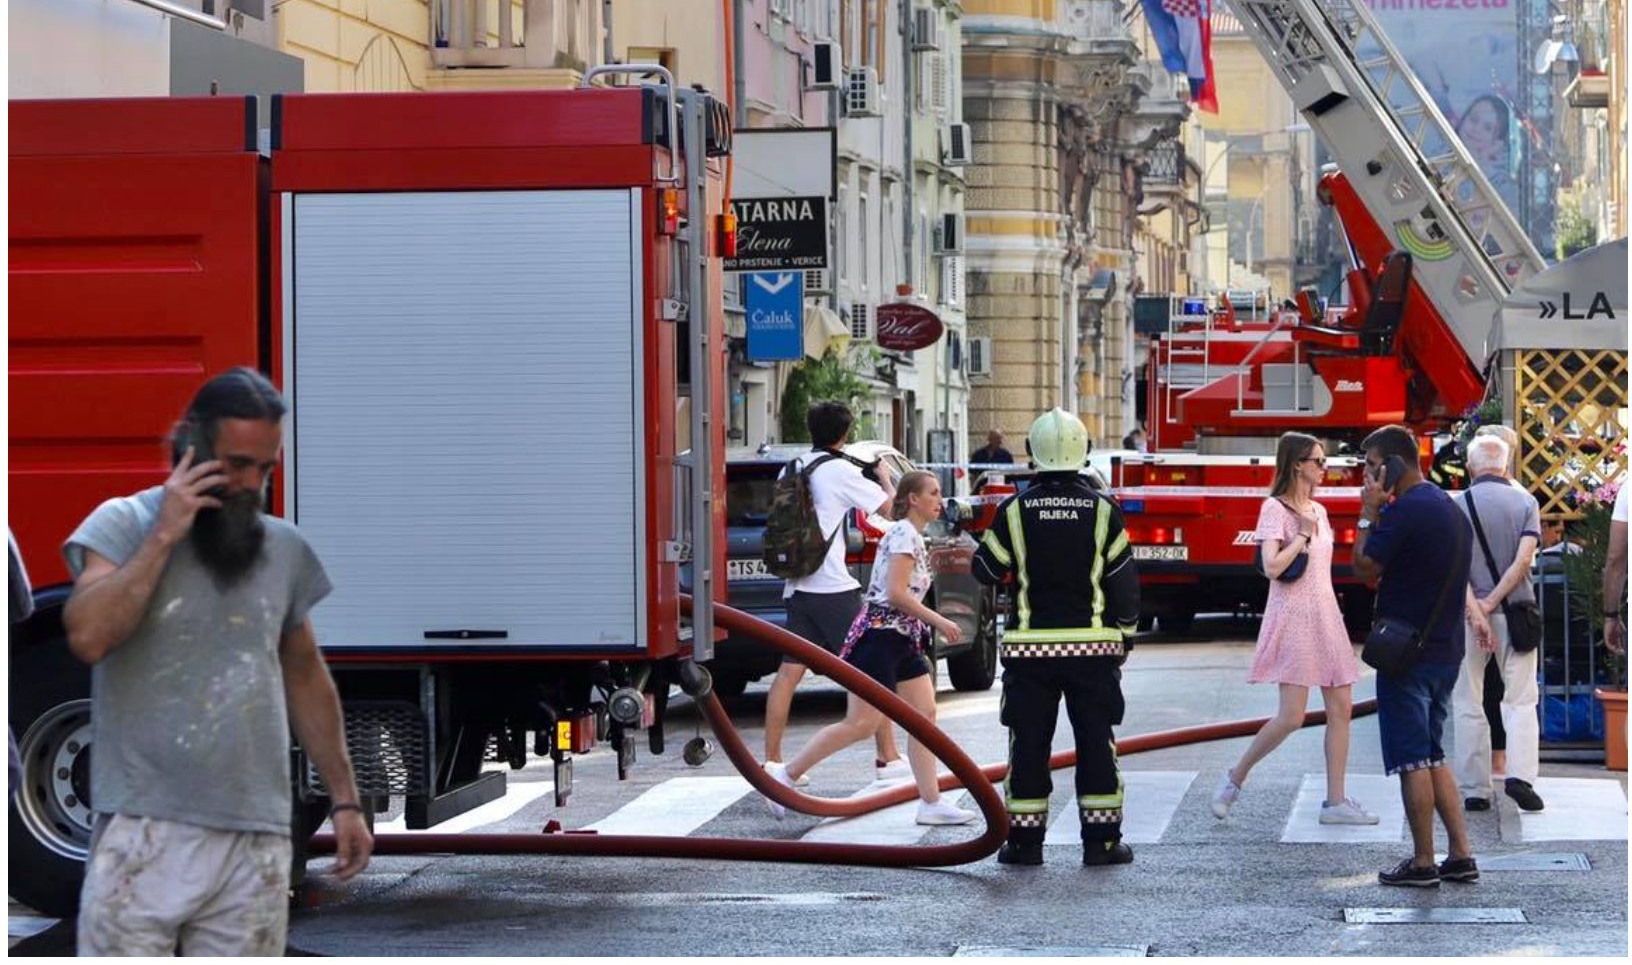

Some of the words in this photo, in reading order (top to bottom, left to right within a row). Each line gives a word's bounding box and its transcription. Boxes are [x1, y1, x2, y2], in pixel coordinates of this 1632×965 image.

[740, 257, 783, 267] PRSTENJE
[792, 256, 823, 266] VERICE
[1024, 497, 1094, 509] VATROGASCI
[1039, 510, 1079, 521] RIJEKA
